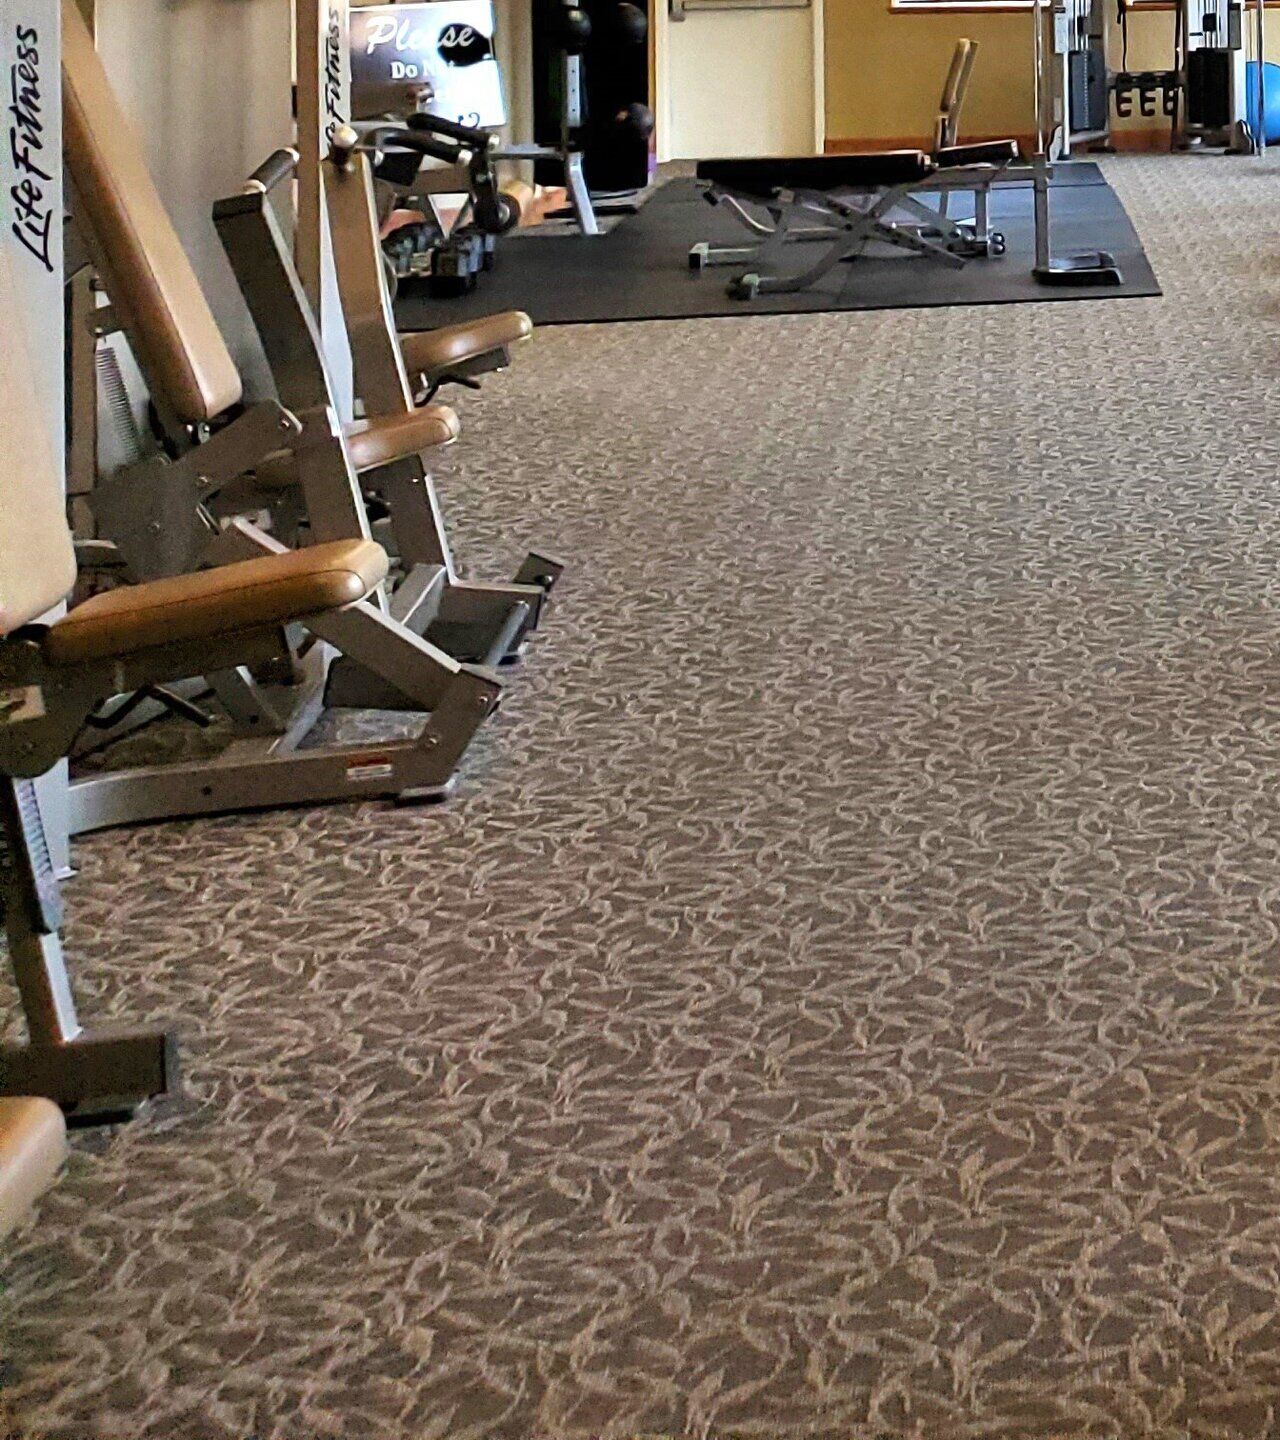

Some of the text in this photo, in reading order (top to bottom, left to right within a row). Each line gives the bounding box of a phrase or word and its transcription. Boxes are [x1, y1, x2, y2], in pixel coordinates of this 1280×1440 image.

[365, 15, 475, 55] Plese
[390, 62, 418, 79] Do
[9, 24, 53, 272] Life Fitness
